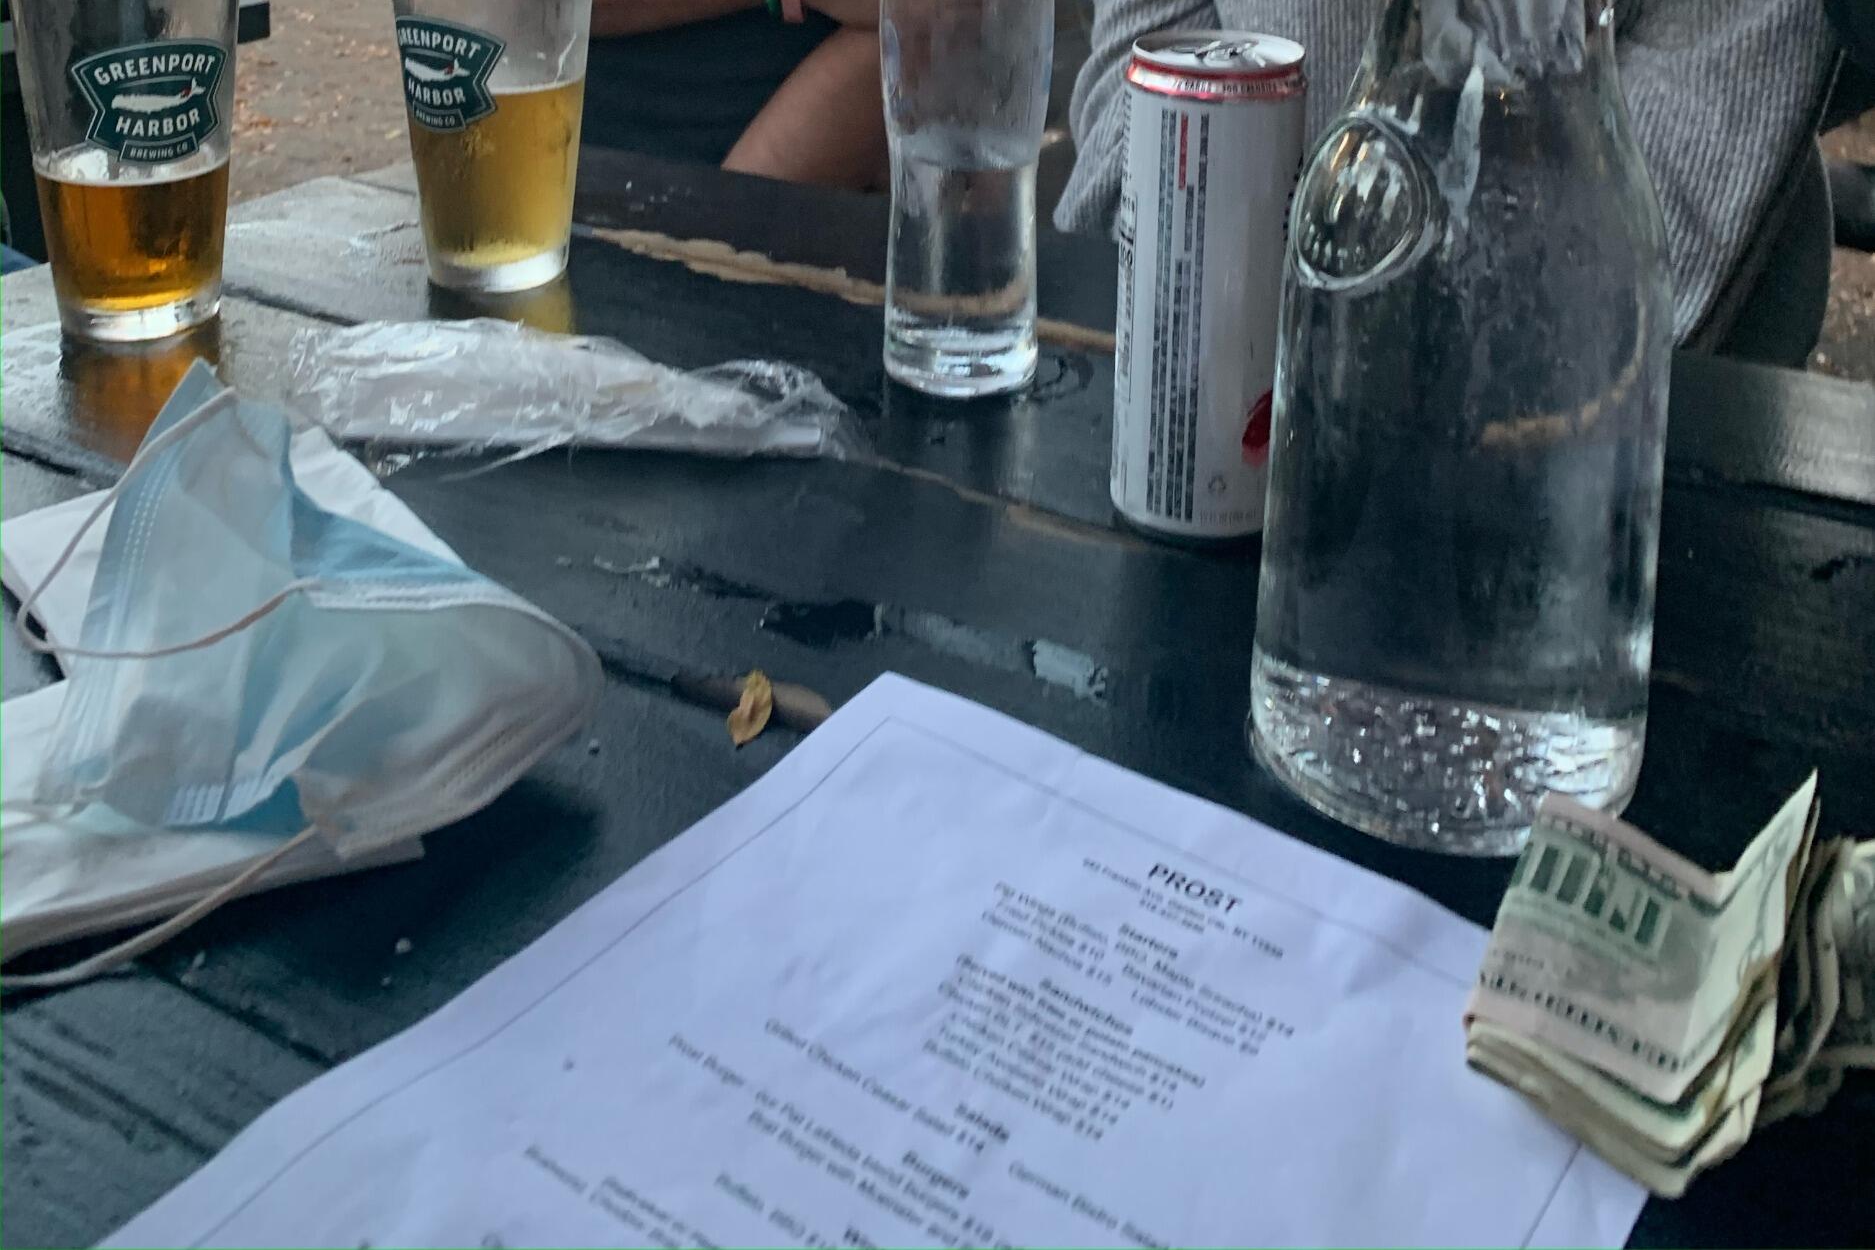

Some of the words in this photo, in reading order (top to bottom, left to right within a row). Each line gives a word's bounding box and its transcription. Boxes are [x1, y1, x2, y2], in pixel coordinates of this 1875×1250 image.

[398, 27, 481, 59] REENPORT
[94, 53, 215, 85] GREENPORT
[408, 77, 466, 106] HARBOR
[115, 108, 200, 137] HARBOR
[130, 147, 174, 160] BREWING
[1149, 861, 1243, 912] PROST
